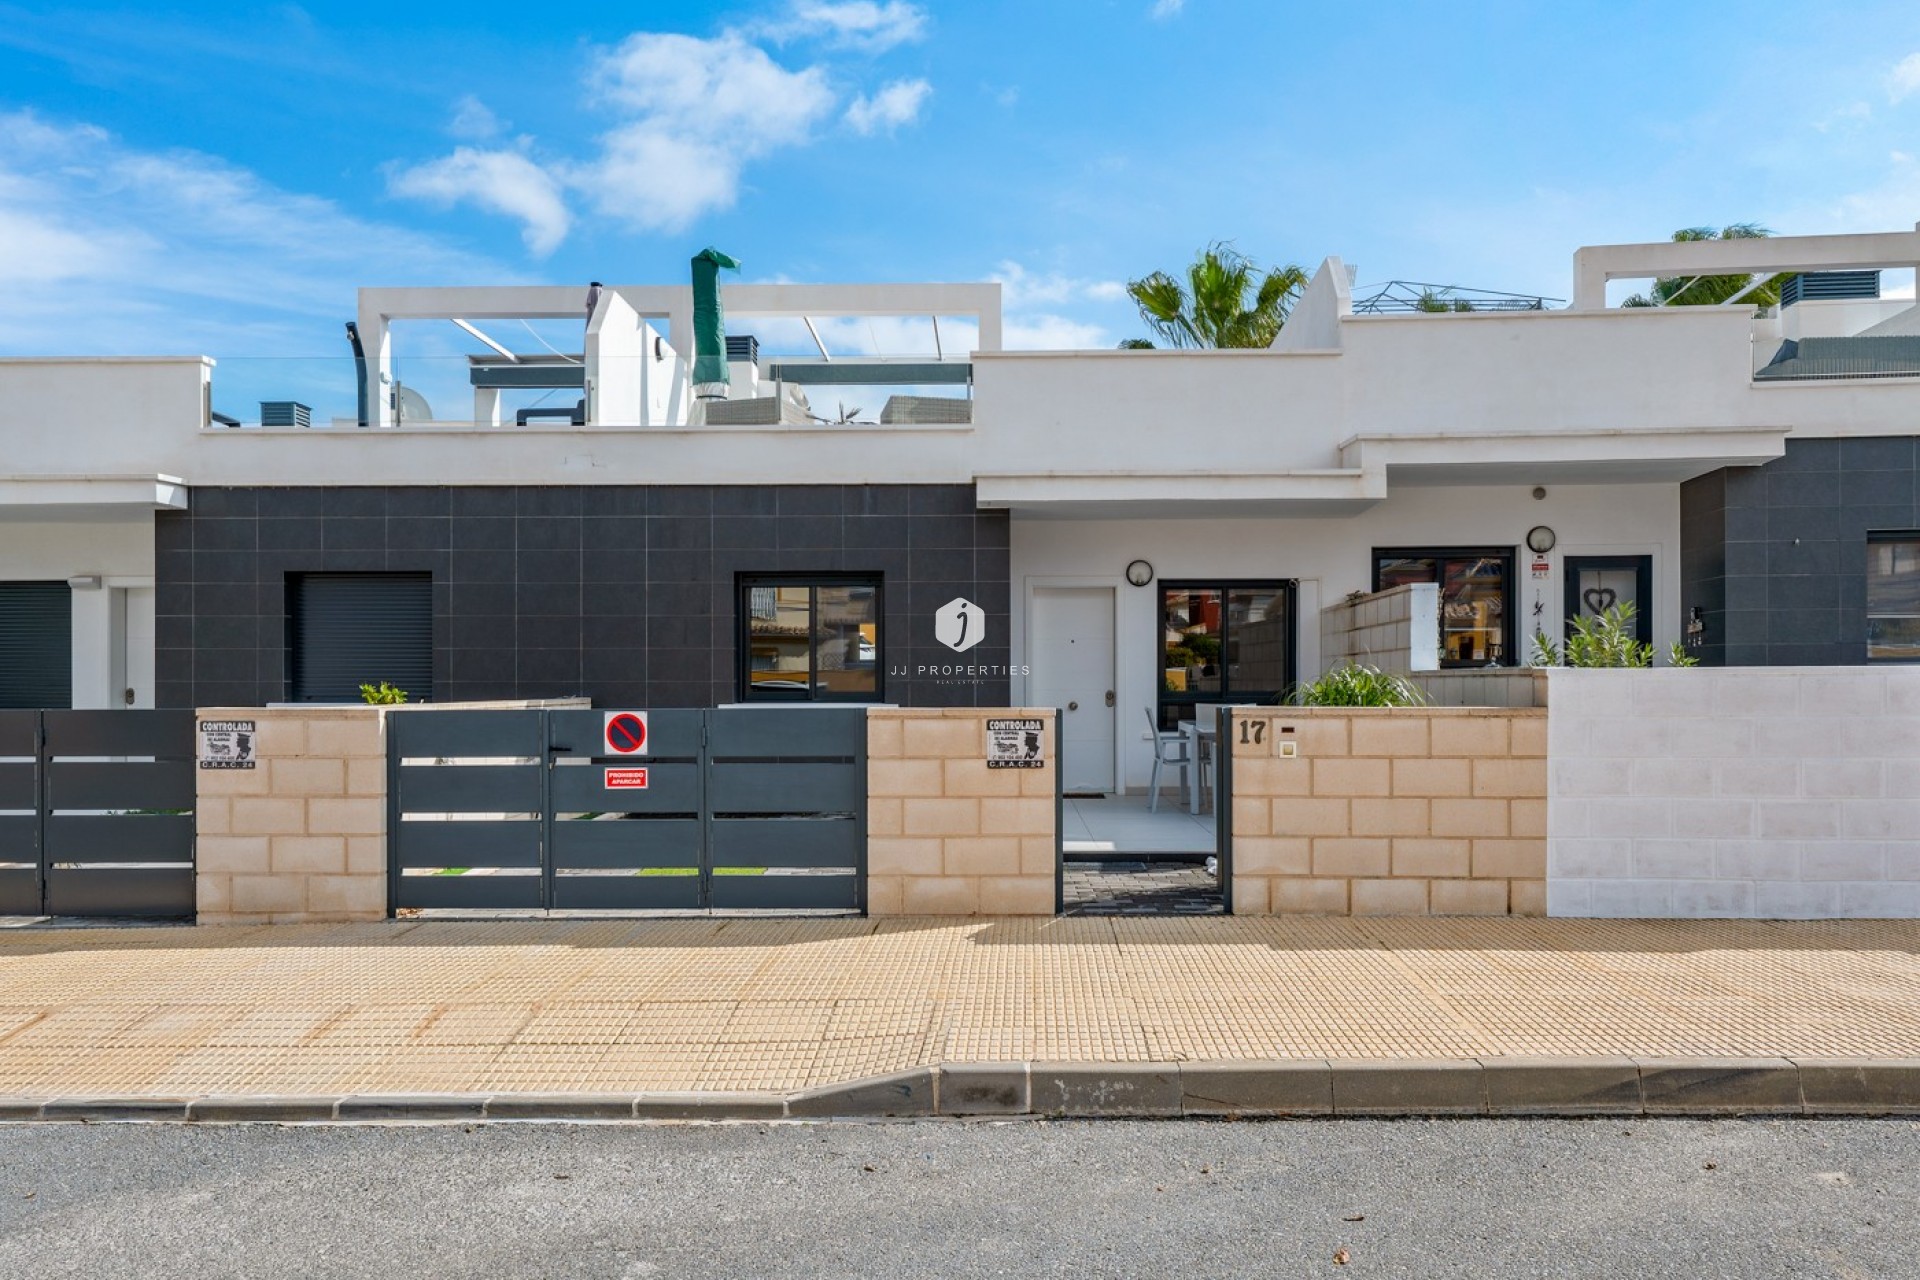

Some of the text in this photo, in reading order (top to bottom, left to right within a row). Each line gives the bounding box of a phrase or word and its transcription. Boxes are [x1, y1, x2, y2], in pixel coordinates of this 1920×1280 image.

[202, 722, 252, 730] CONTROLADA
[990, 720, 1041, 730] CONTROLADA
[1240, 720, 1267, 745] 17
